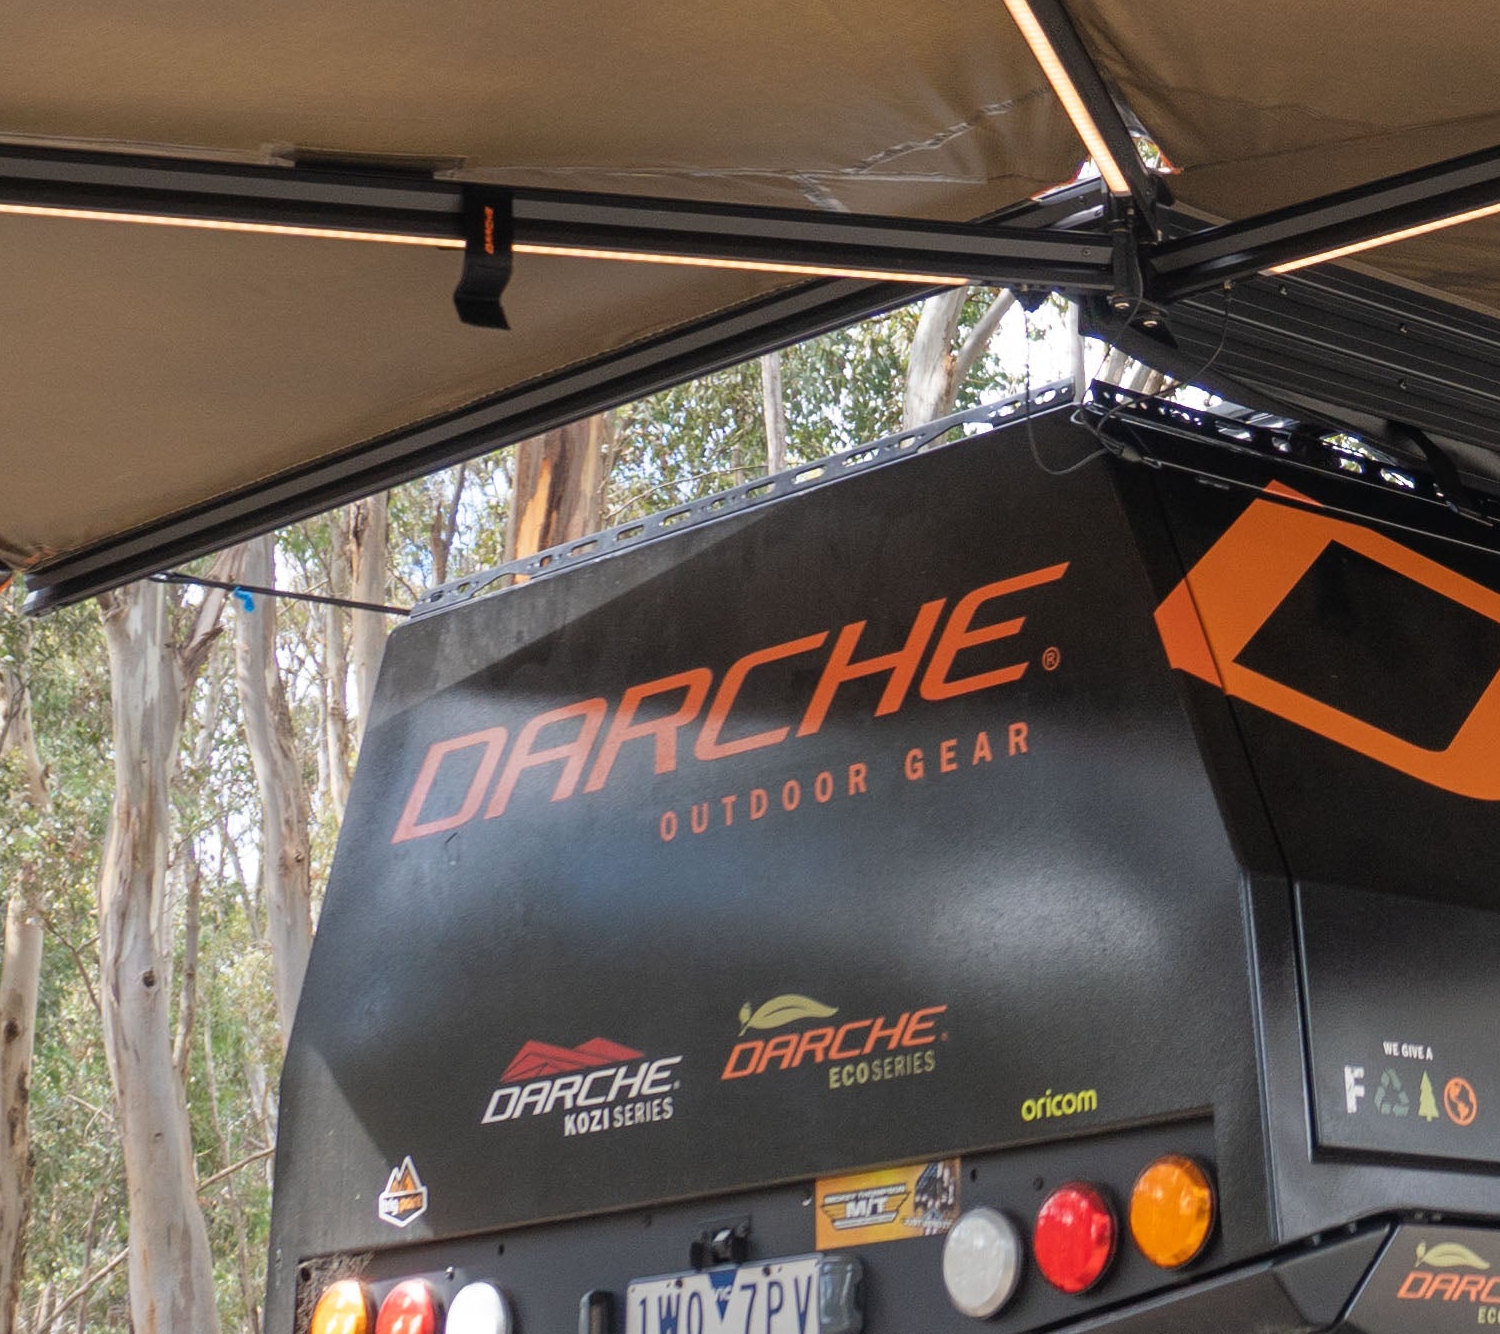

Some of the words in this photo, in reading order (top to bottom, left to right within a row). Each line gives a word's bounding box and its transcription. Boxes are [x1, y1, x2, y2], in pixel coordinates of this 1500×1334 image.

[391, 561, 1070, 845] DARCHE
[659, 762, 868, 842] OUTDOOR
[905, 722, 1030, 782] GEAR
[719, 1004, 948, 1081] DARCHE
[1382, 1041, 1399, 1057] WE
[1401, 1043, 1425, 1060] GIVE
[1425, 1047, 1434, 1061] A
[481, 1055, 683, 1124] DARCHE
[1021, 1088, 1098, 1122] oricom
[1344, 1064, 1365, 1114] F
